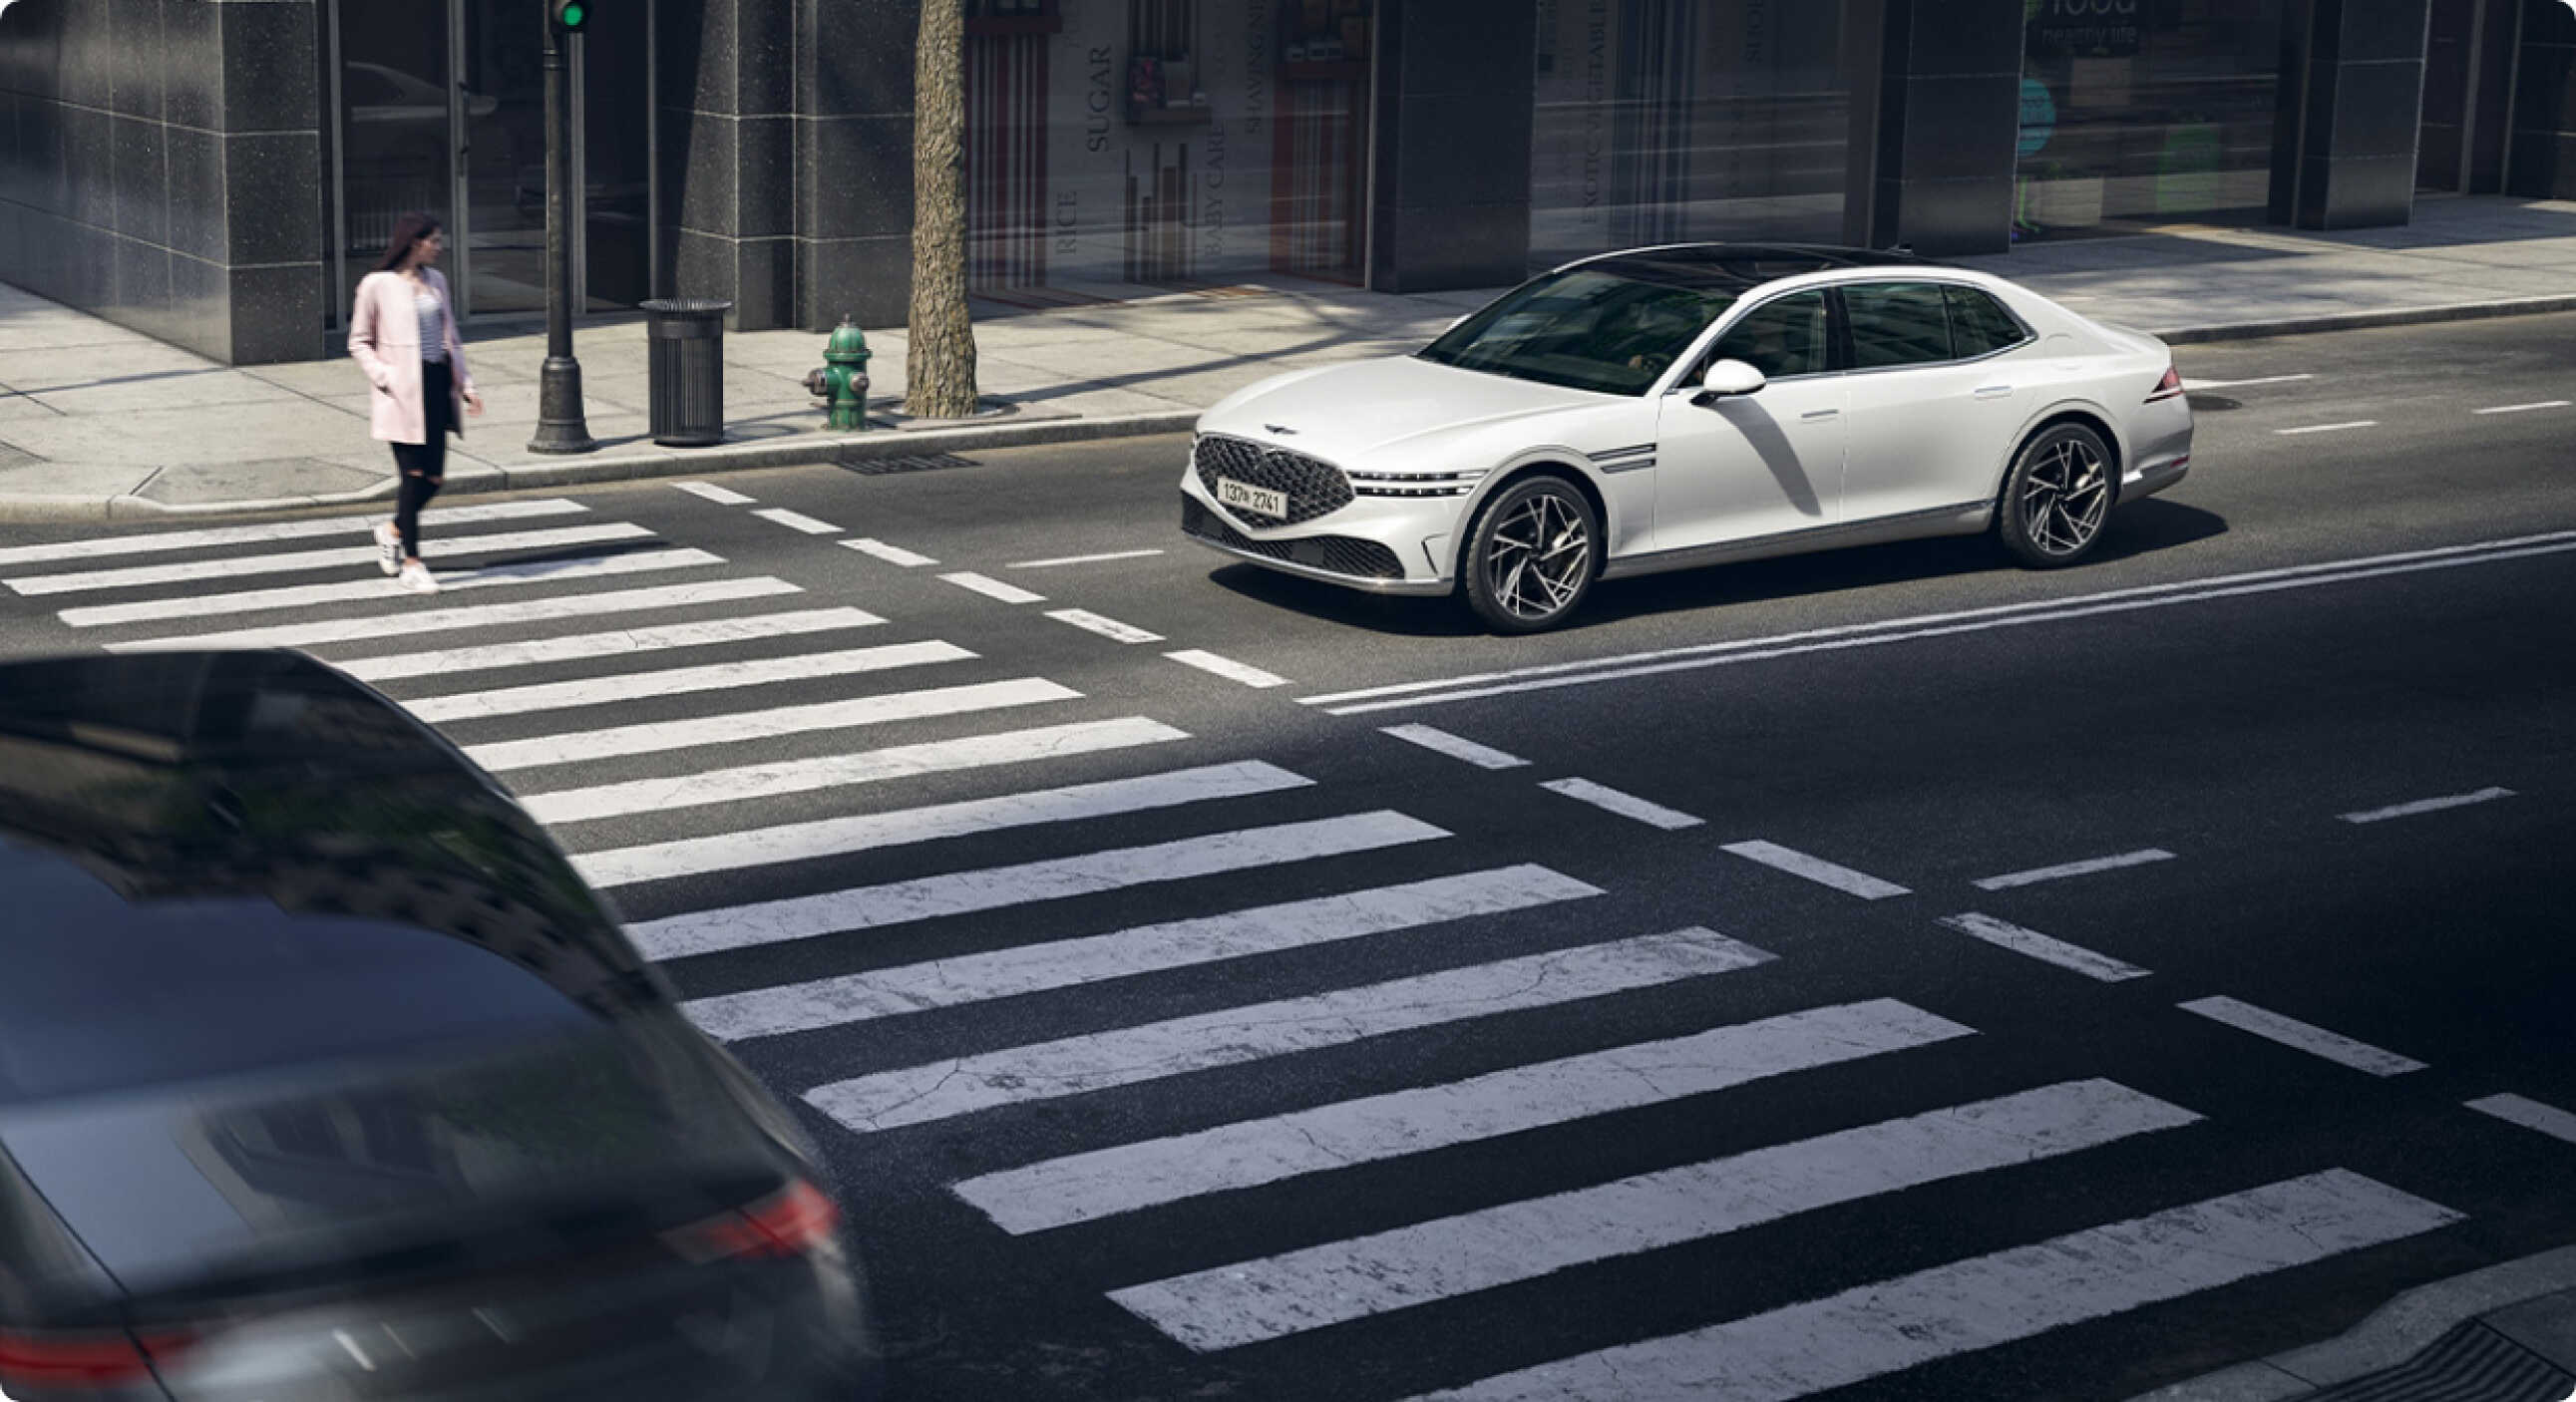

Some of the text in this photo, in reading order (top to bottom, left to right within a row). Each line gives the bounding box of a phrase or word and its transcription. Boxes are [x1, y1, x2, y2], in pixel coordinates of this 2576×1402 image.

[1087, 45, 1112, 153] SUGAR
[1246, 33, 1265, 136] SHAVING
[1056, 190, 1077, 256] RICE
[1205, 124, 1226, 256] BABY CARE
